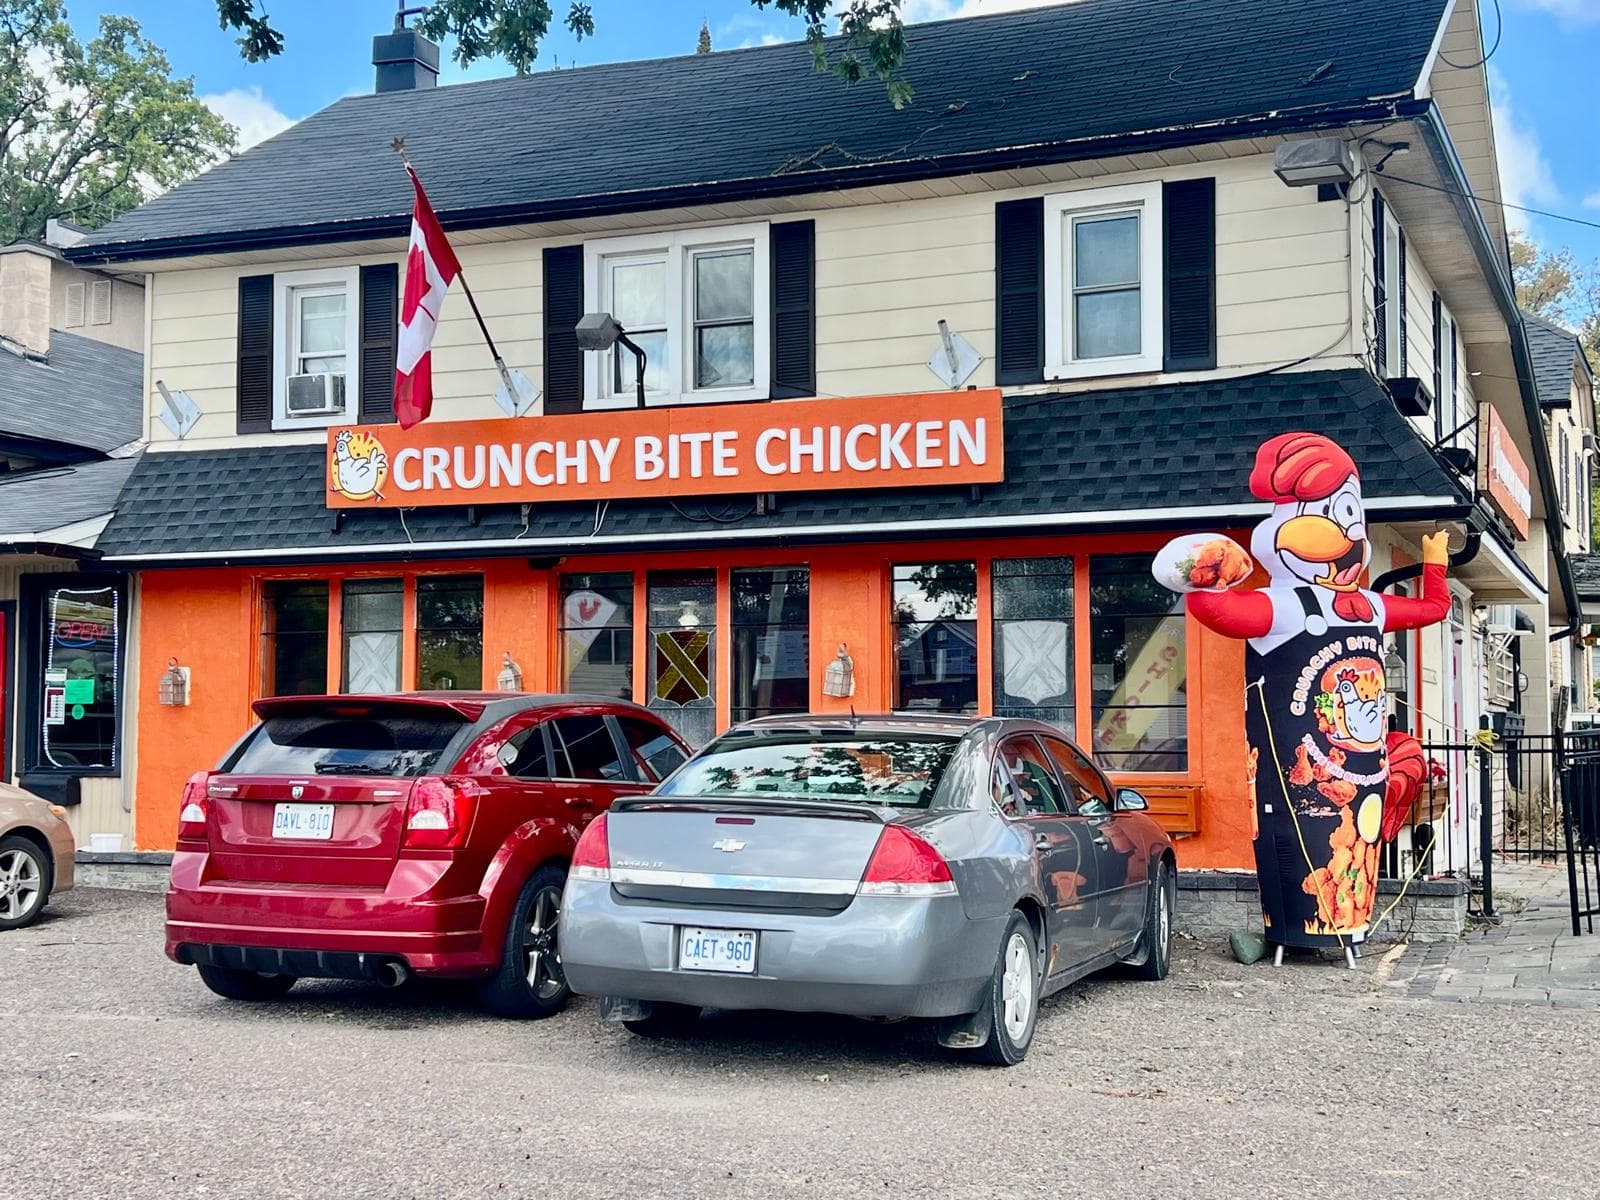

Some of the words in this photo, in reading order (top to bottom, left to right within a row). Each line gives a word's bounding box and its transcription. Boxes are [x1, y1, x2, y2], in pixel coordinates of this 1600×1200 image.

[391, 436, 621, 492] CRUNCHY
[634, 429, 740, 480] BITE
[755, 417, 988, 475] CHICKEN
[1100, 645, 1178, 746] CHICKE
[1290, 640, 1343, 716] CRUNCHY
[1346, 635, 1377, 652] BITE
[276, 811, 302, 830] DAVL
[309, 813, 330, 830] 810
[684, 938, 719, 959] CAET
[726, 940, 753, 961] 960
